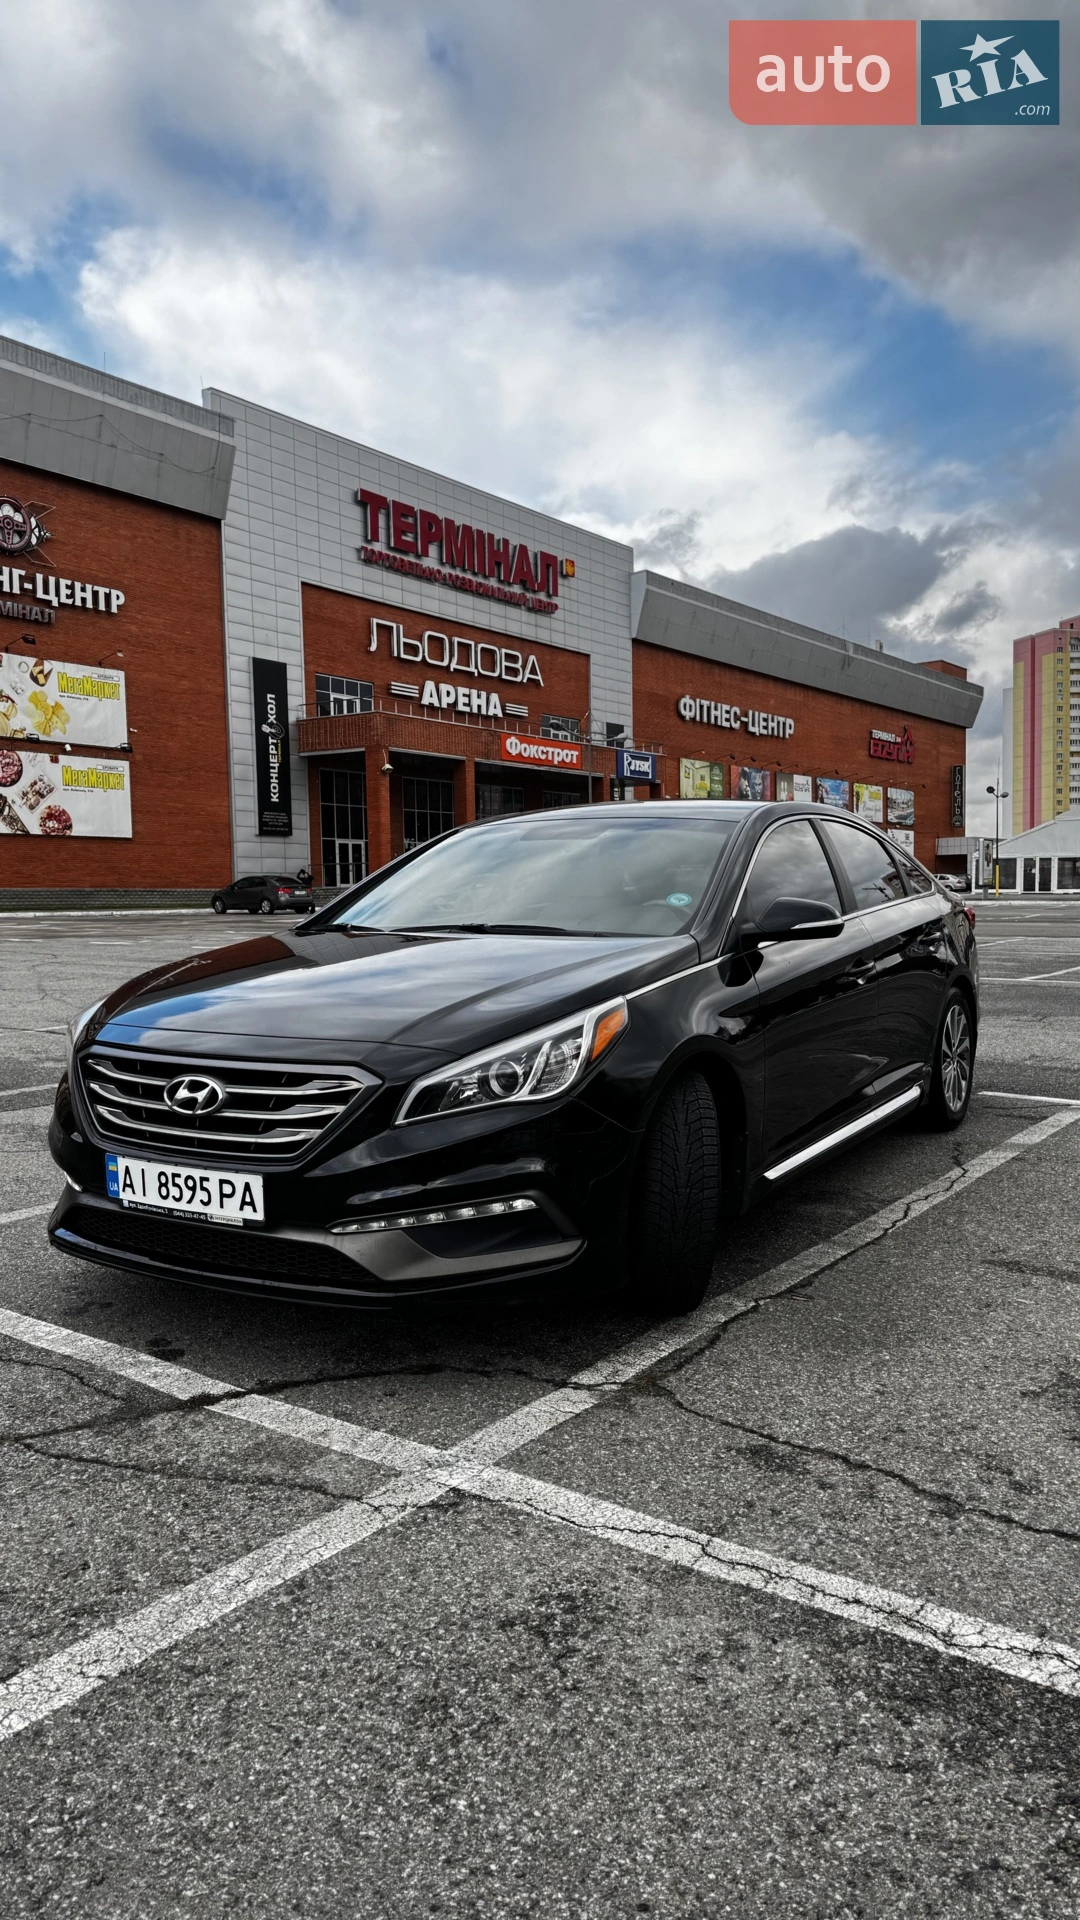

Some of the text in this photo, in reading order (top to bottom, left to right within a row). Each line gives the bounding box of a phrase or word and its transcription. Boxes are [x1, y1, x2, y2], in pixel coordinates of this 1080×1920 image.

[357, 488, 558, 597] ТЕРМІНАЛ
[529, 596, 559, 614] ЦЕНТР
[368, 617, 544, 687] ЛЬОДОВА
[57, 671, 120, 701] МегаМаркет
[421, 680, 503, 717] АРЕНА
[679, 695, 795, 739] ФІТНЕС-ЦЕНТР
[267, 694, 279, 802] КОНЦЕРТ ХОЛ
[506, 736, 579, 765] Фокстрот
[62, 765, 125, 792] МегаМаркет
[630, 759, 650, 773] JYSK
[109, 1181, 119, 1191] UA
[122, 1165, 258, 1213] AI 8595 PA
